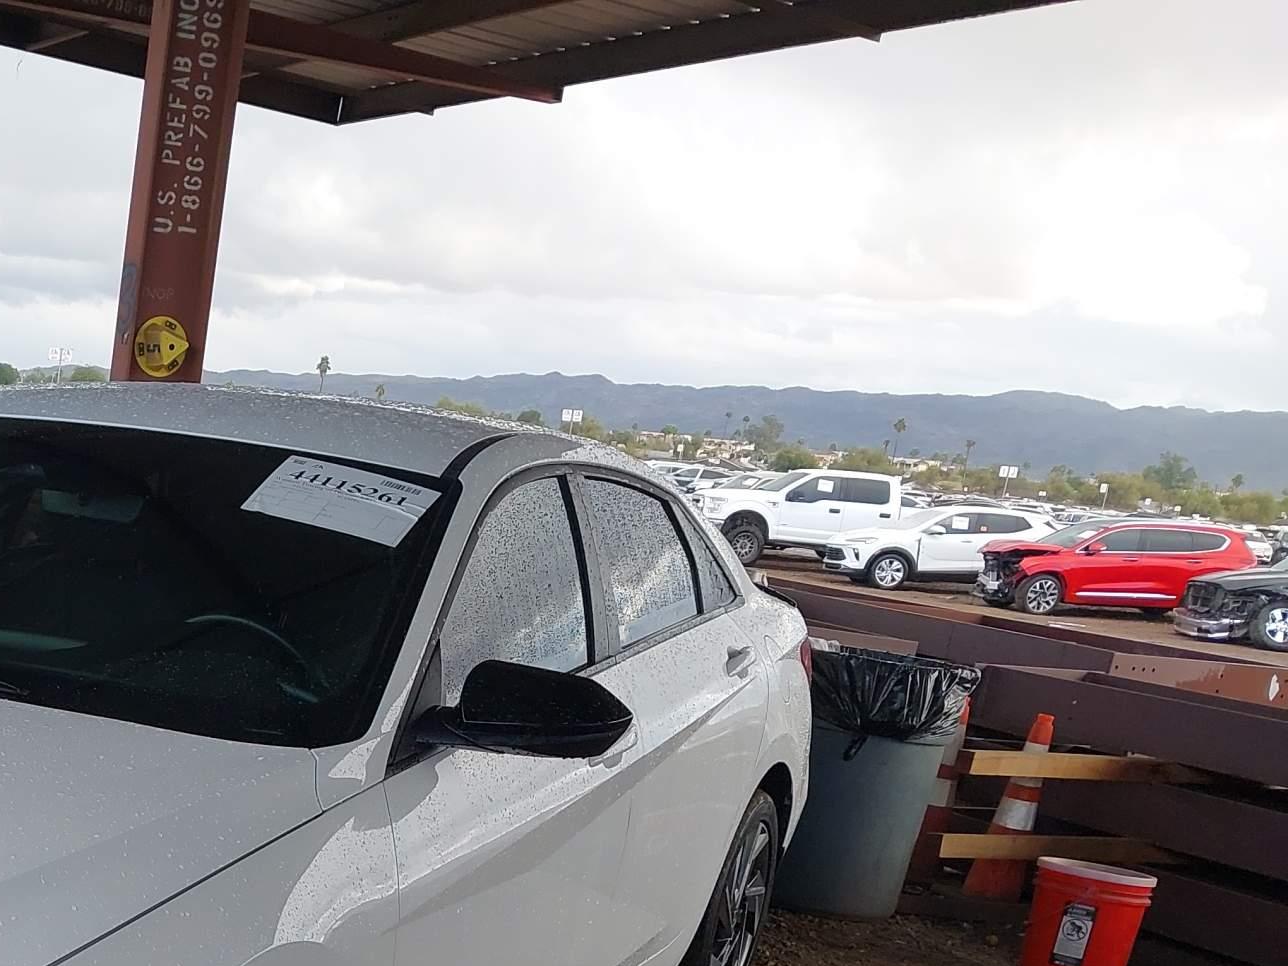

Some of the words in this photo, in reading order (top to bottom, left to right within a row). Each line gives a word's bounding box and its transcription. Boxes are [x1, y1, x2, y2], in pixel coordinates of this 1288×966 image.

[161, 56, 193, 165] PREFAB
[152, 182, 178, 234] U.S.
[289, 470, 409, 507] 44115261
